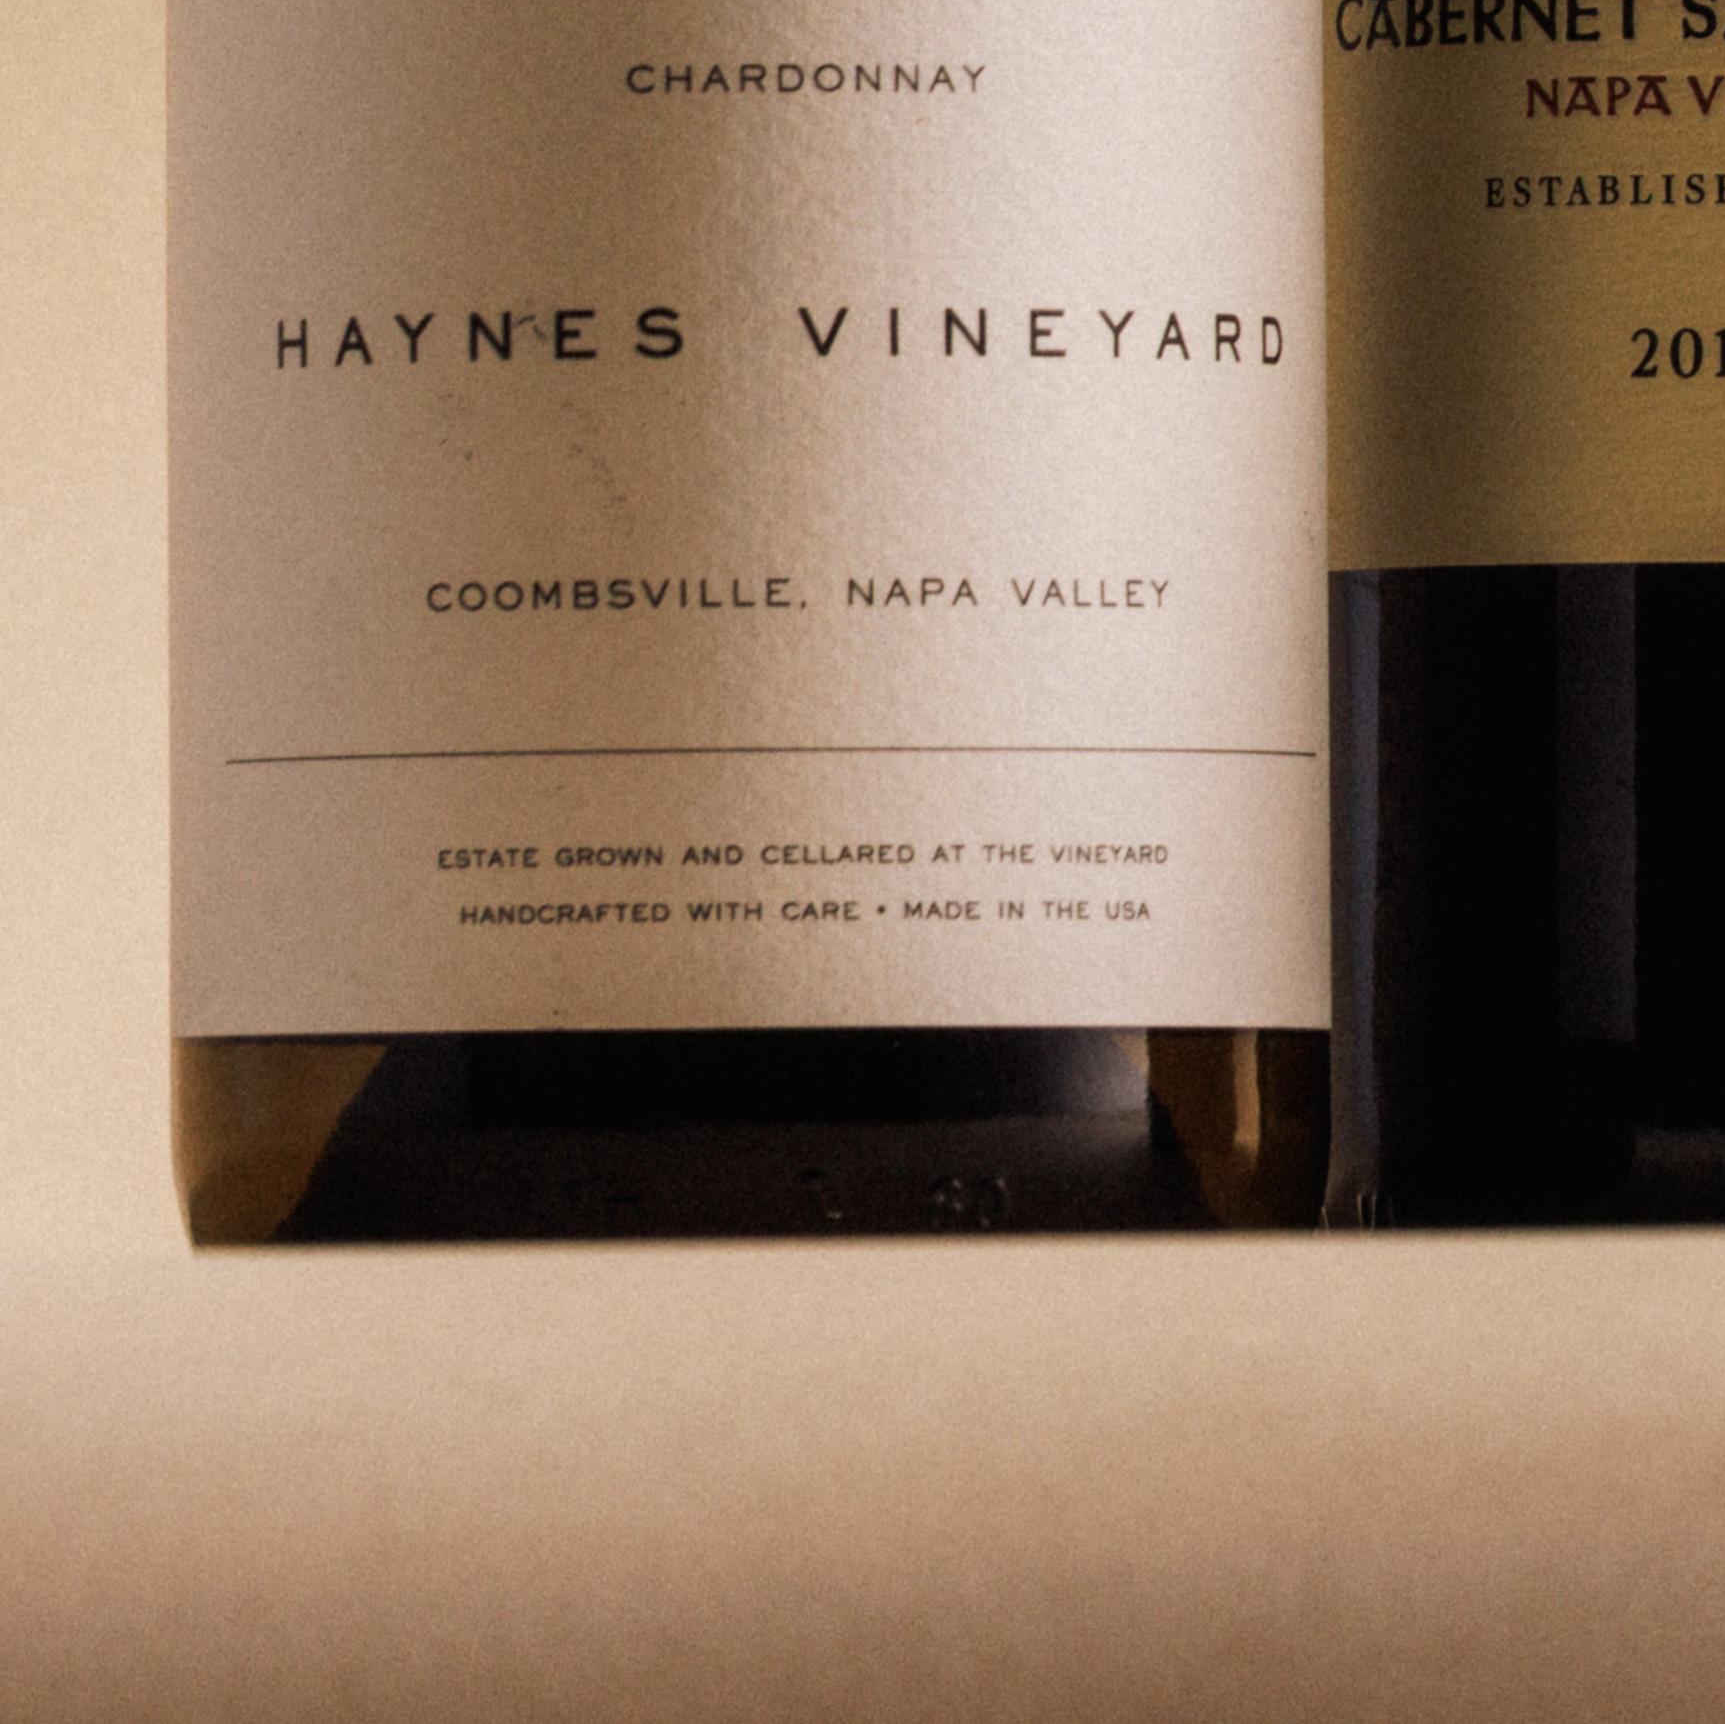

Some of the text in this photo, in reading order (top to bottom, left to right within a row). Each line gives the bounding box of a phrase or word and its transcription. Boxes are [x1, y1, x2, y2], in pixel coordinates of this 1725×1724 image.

[625, 62, 984, 95] CHARDONNAY
[1526, 75, 1672, 119] NAPA
[277, 306, 1283, 368] HAYNES VINEYARD
[426, 577, 1169, 614] COOMBSVILLE, NAPA VALLEY
[437, 843, 1168, 871] ESTATE GROWN AND CELLARED AT THE VINEYARD
[459, 900, 1151, 925] HANDCRAFTED WITH CARE MADE IN THE USA
